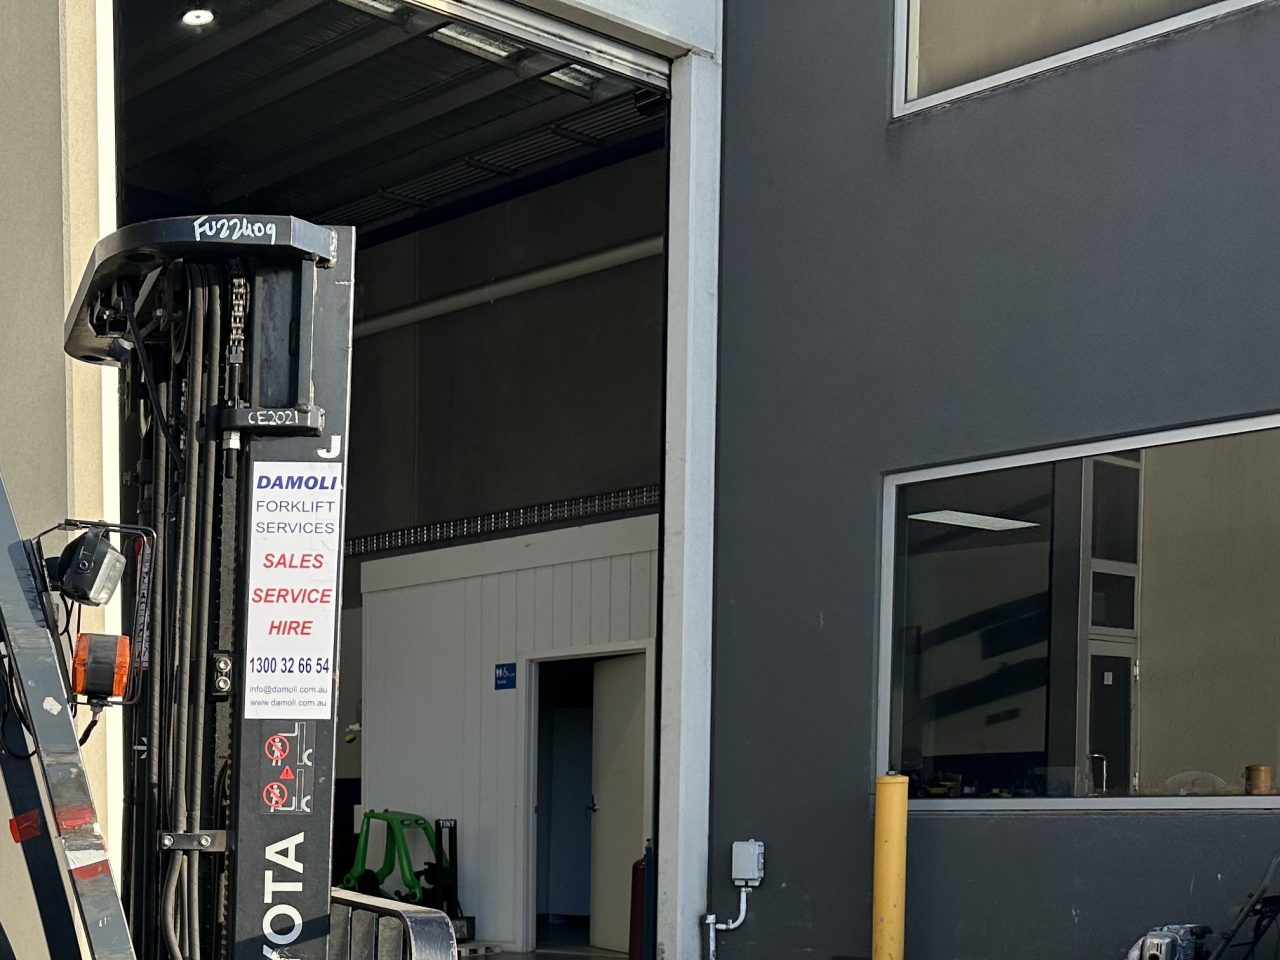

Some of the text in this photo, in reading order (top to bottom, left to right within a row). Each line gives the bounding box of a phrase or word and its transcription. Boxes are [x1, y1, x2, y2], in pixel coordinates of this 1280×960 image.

[247, 410, 299, 425] CE2021
[256, 475, 338, 490] DAMOLI
[255, 500, 335, 513] FORKLIFT
[255, 522, 335, 534] SERVICES
[262, 553, 324, 569] SALES
[251, 588, 333, 604] SERVICE
[268, 620, 313, 636] HIRE
[249, 657, 330, 674] 1300 32 66 54
